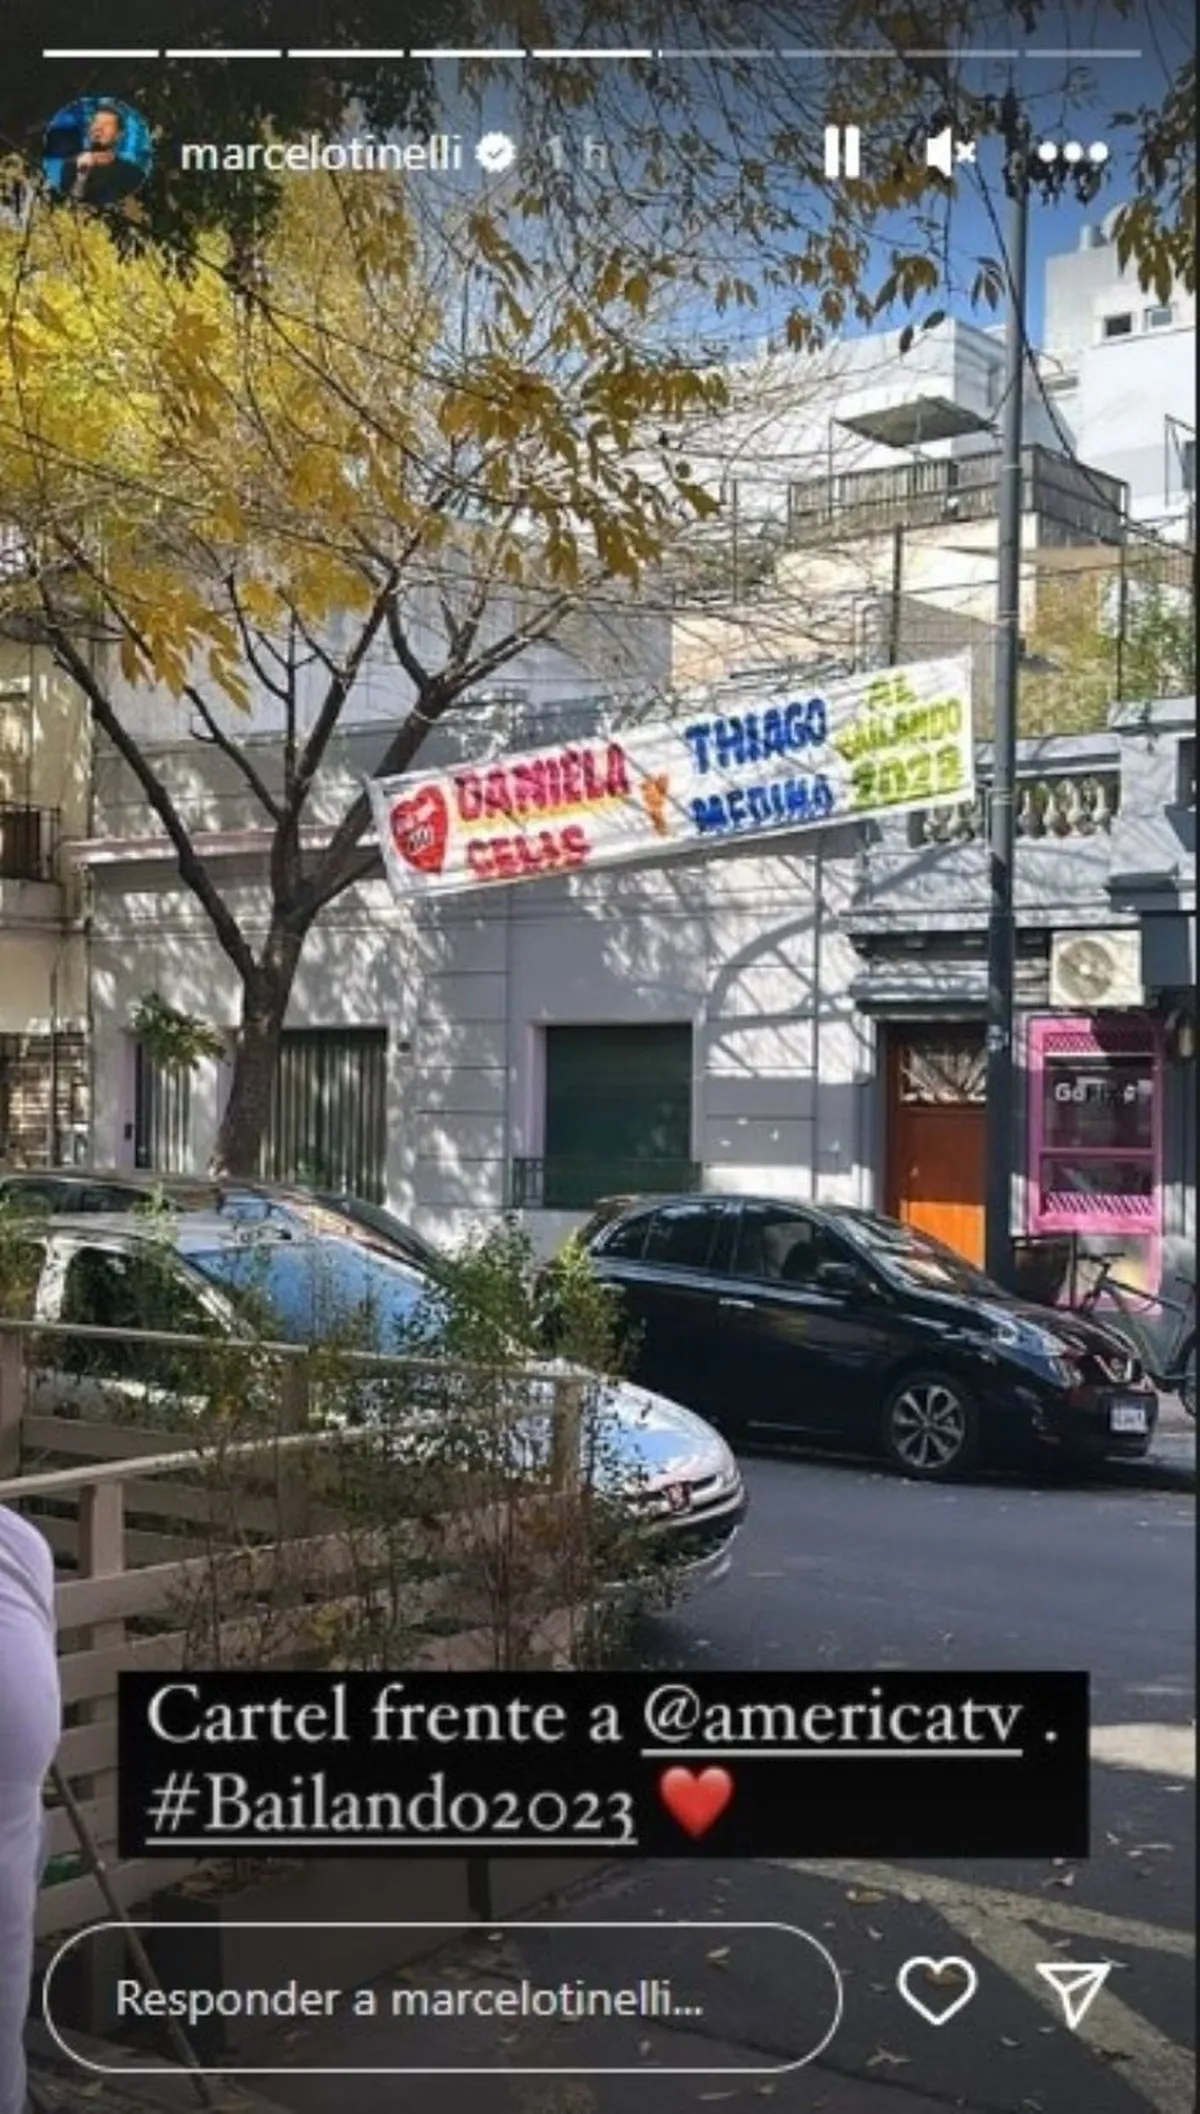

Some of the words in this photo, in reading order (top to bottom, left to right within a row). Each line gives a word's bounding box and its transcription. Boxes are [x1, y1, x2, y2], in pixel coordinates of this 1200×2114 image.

[685, 697, 827, 776] THIAGO
[454, 742, 630, 821] DANIELA
[640, 773, 670, 837] Y
[690, 773, 837, 833] MEDINA
